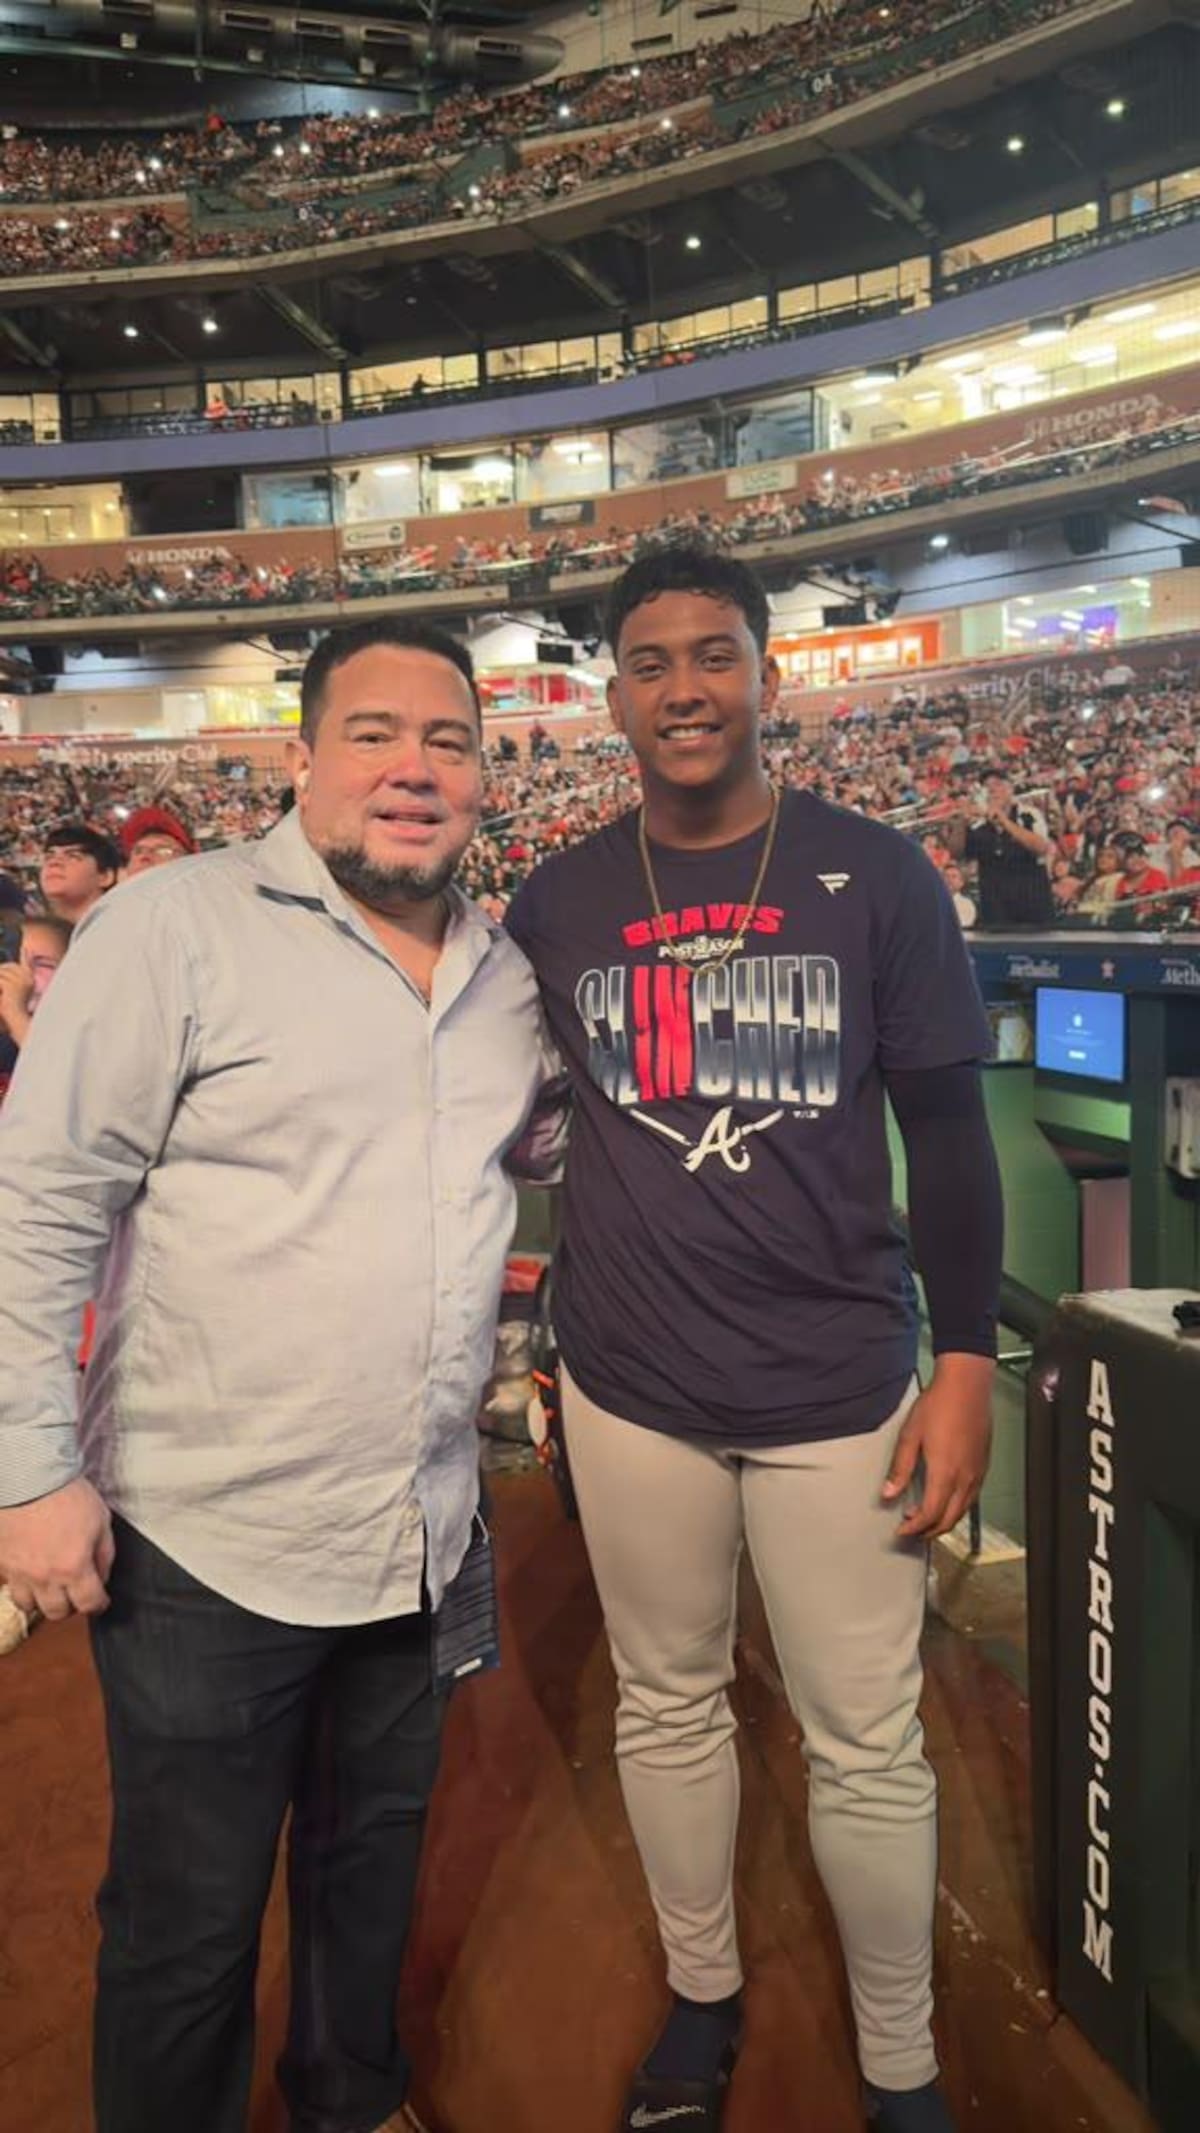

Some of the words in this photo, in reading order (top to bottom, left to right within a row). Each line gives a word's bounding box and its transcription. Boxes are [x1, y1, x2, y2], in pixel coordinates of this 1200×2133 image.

[1051, 394, 1162, 432] HONDA
[147, 547, 232, 564] HONDA
[622, 902, 784, 948] BRAVES
[575, 954, 840, 1106] CLINCHED
[1083, 1359, 1115, 1984] ASTROS.COM
